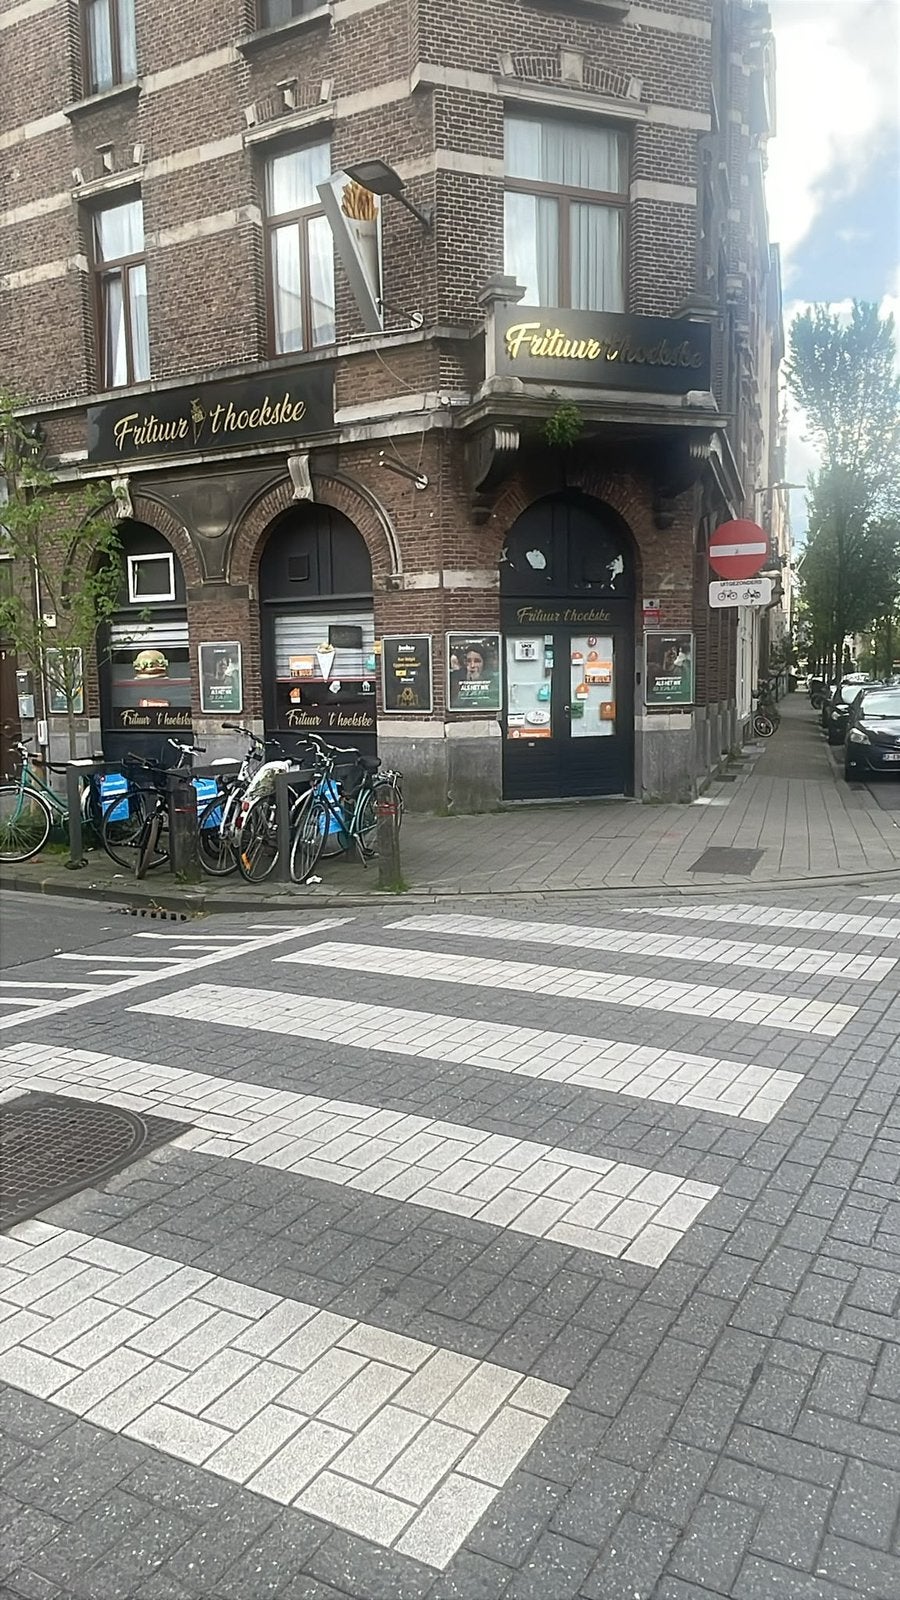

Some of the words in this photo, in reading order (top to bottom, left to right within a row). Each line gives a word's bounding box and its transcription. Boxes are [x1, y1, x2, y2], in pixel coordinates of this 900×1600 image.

[505, 322, 601, 360] Frituur
[114, 412, 190, 451] Frituur
[516, 606, 560, 623] Frituur
[120, 709, 151, 726] Frituur
[285, 708, 322, 727] Frituur
